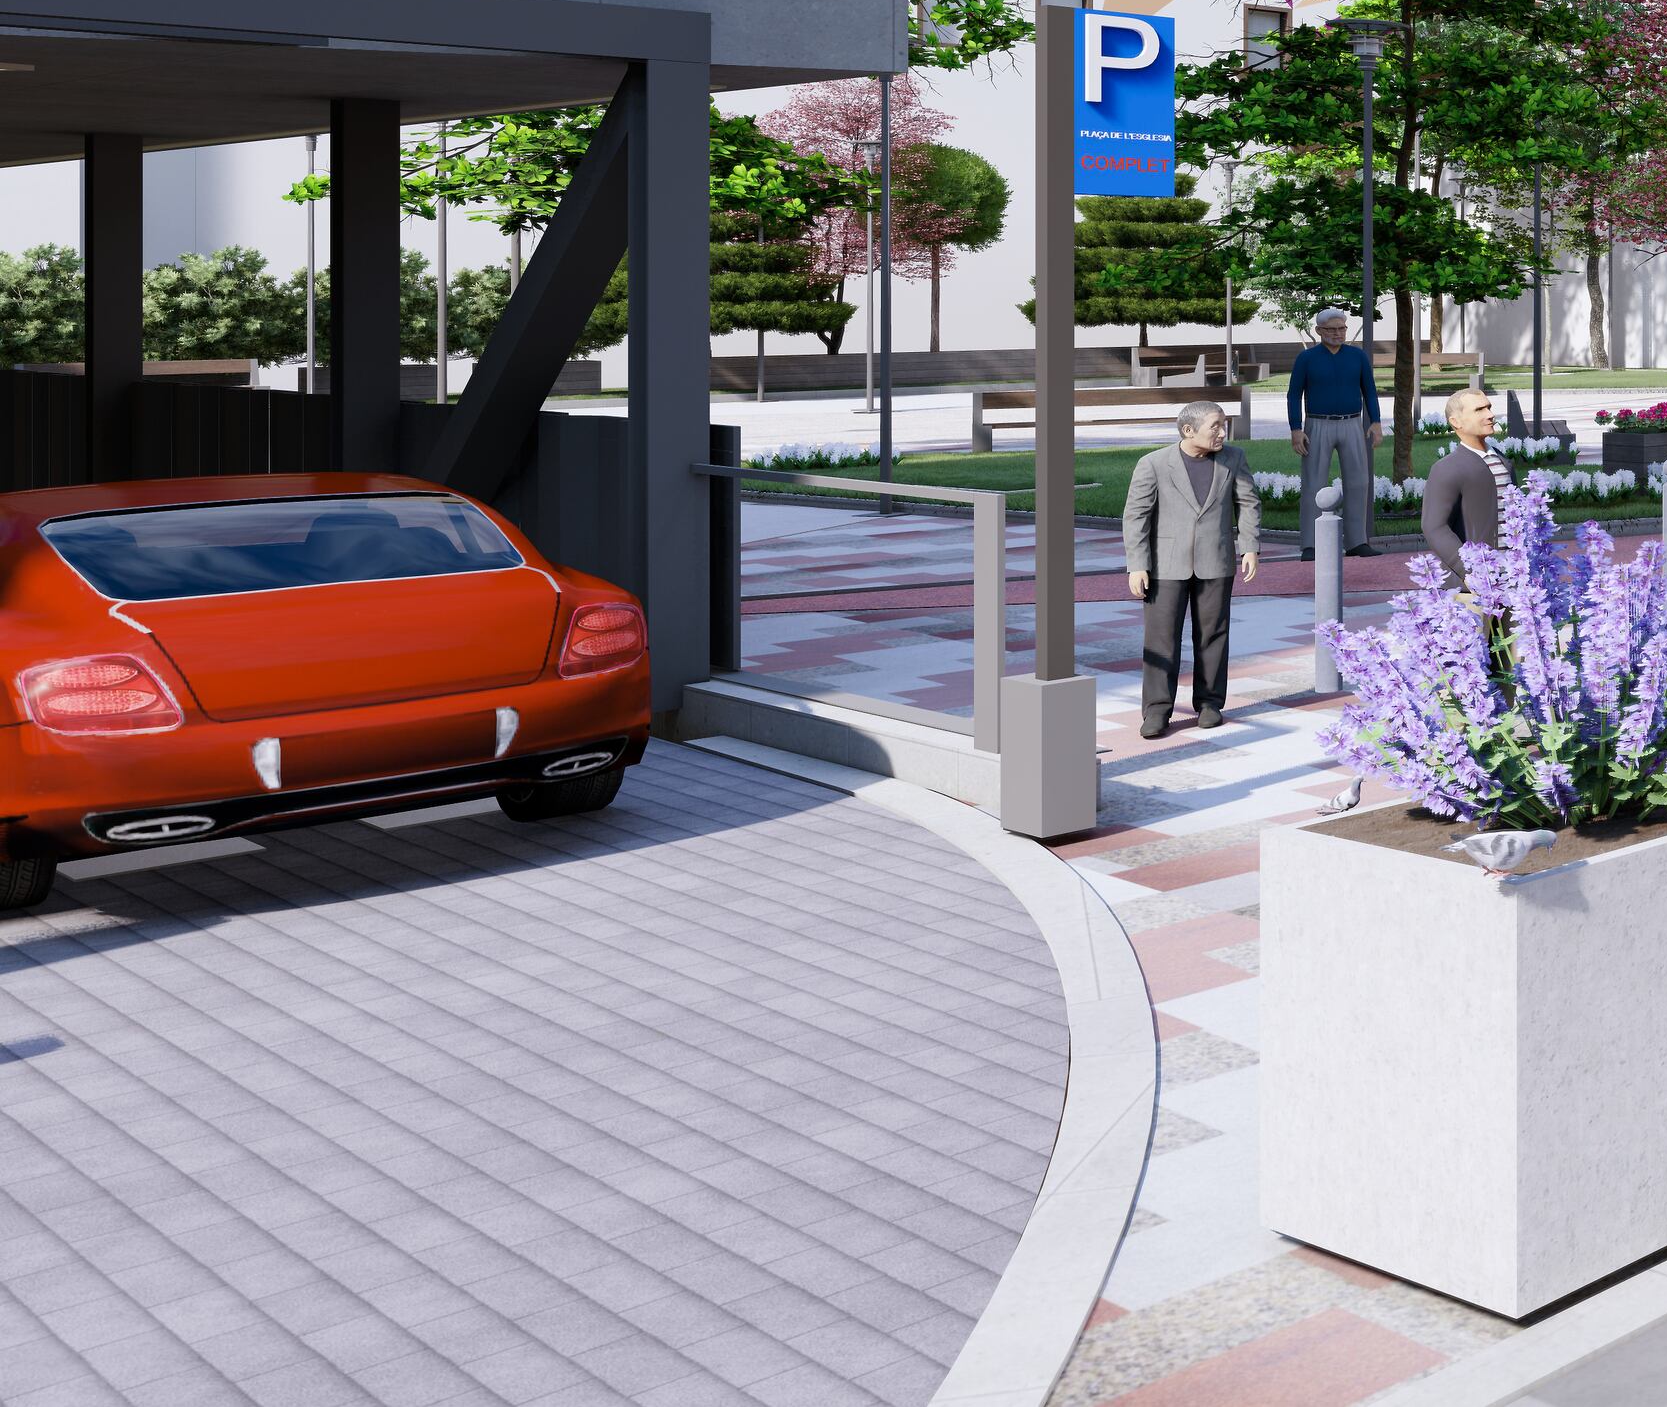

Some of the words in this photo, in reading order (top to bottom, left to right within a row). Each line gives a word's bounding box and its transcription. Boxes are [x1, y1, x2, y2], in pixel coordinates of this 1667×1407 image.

[1085, 13, 1160, 103] P
[1080, 130, 1110, 140] PLAÇA
[1111, 131, 1123, 139] DE
[1081, 155, 1170, 173] COMPLET
